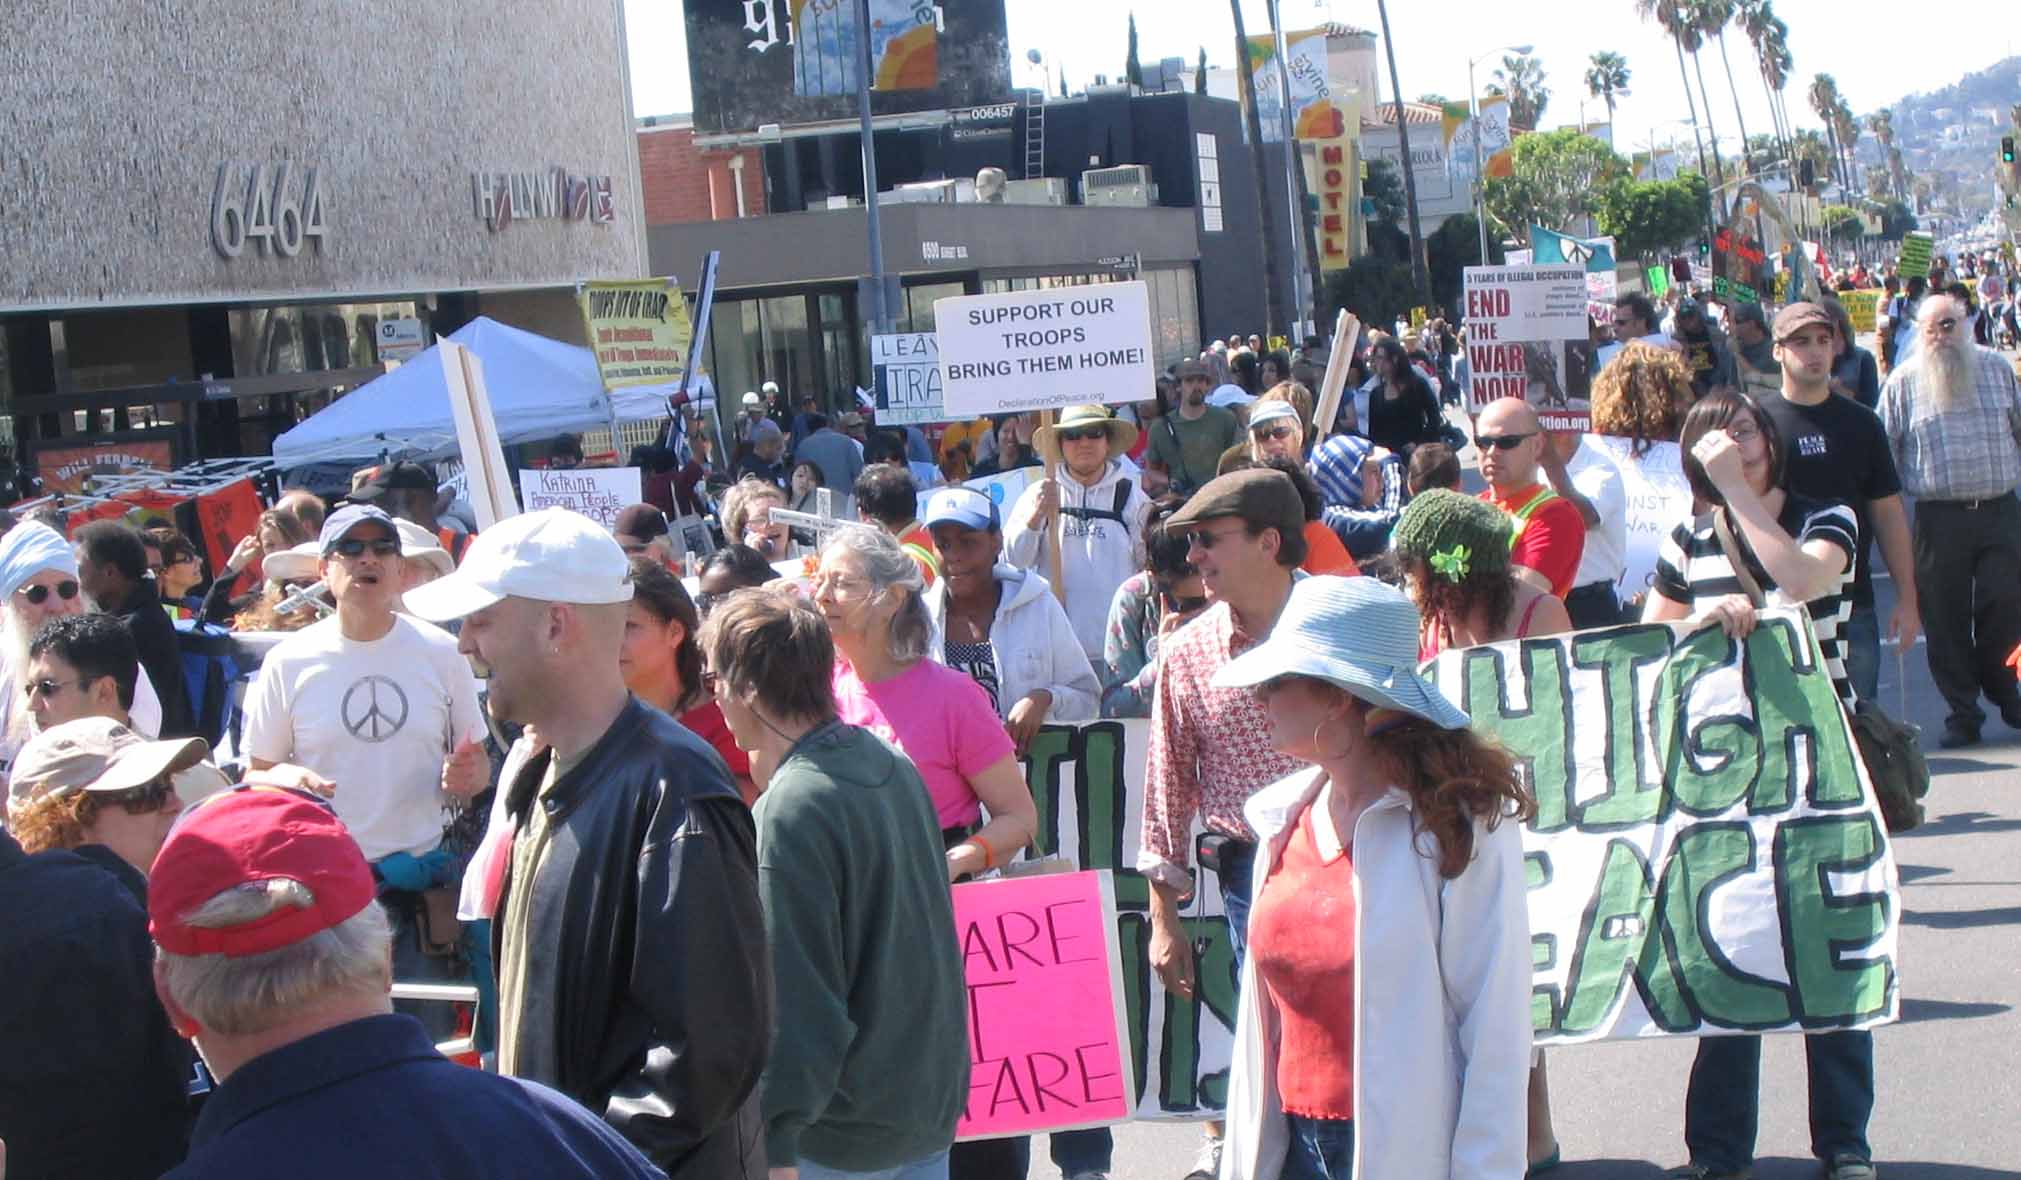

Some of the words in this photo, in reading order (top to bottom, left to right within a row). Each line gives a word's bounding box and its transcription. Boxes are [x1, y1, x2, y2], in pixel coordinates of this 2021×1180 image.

[971, 106, 1014, 120] 006457
[212, 160, 326, 258] 6464
[1321, 146, 1344, 257] MOTEL
[1474, 273, 1496, 283] YEARS
[1497, 272, 1505, 281] OF
[1507, 271, 1535, 281] ILLEGAL
[1536, 270, 1584, 281] OCCUPATION
[968, 302, 1065, 326] SUPPORT
[1070, 298, 1115, 317] OUR
[1468, 289, 1511, 318] END
[1588, 303, 1617, 325] PEAC
[1002, 327, 1086, 349] TROOPS
[1469, 323, 1498, 340] THE
[948, 359, 1012, 380] BRING
[1017, 354, 1074, 376] THEM
[1079, 348, 1145, 369] HOME!
[1470, 344, 1525, 373] WAR
[888, 367, 944, 405] IRA
[998, 391, 1105, 409] DeclarationOfPeace.org
[1473, 377, 1527, 404] NOW
[1461, 618, 1865, 833] HIGH
[1523, 812, 1894, 1037] EACE
